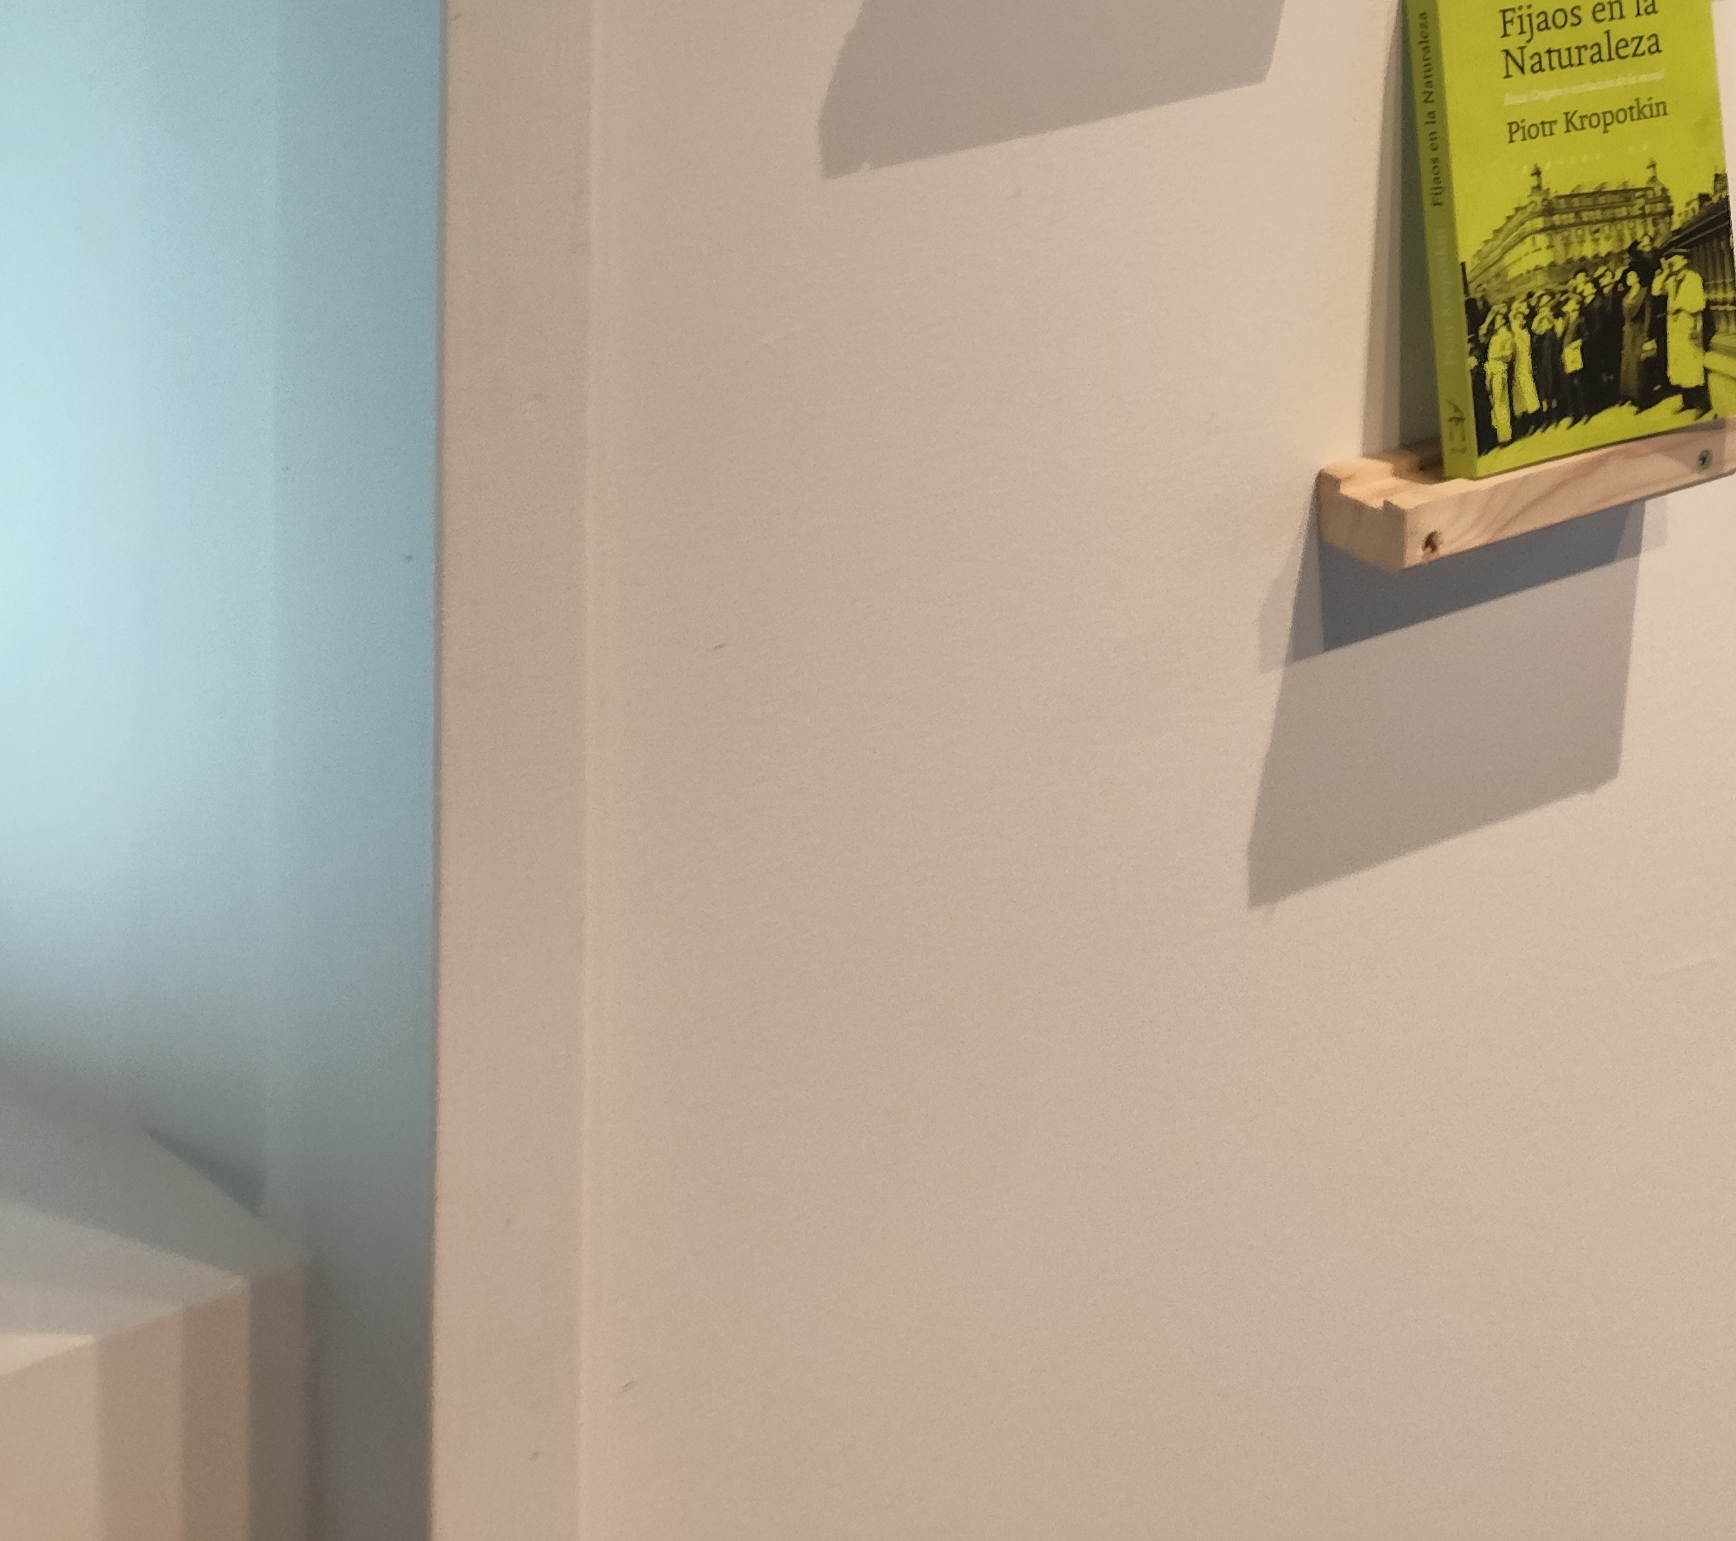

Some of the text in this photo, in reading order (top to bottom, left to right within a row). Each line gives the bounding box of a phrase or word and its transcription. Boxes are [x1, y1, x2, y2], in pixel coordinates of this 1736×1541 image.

[1499, 4, 1583, 44] Fijaos
[1591, 0, 1627, 24] en
[1416, 11, 1436, 105] Naturaleza
[1501, 29, 1664, 80] Naturaleza
[1507, 97, 1670, 145] Piotr Kropotkin
